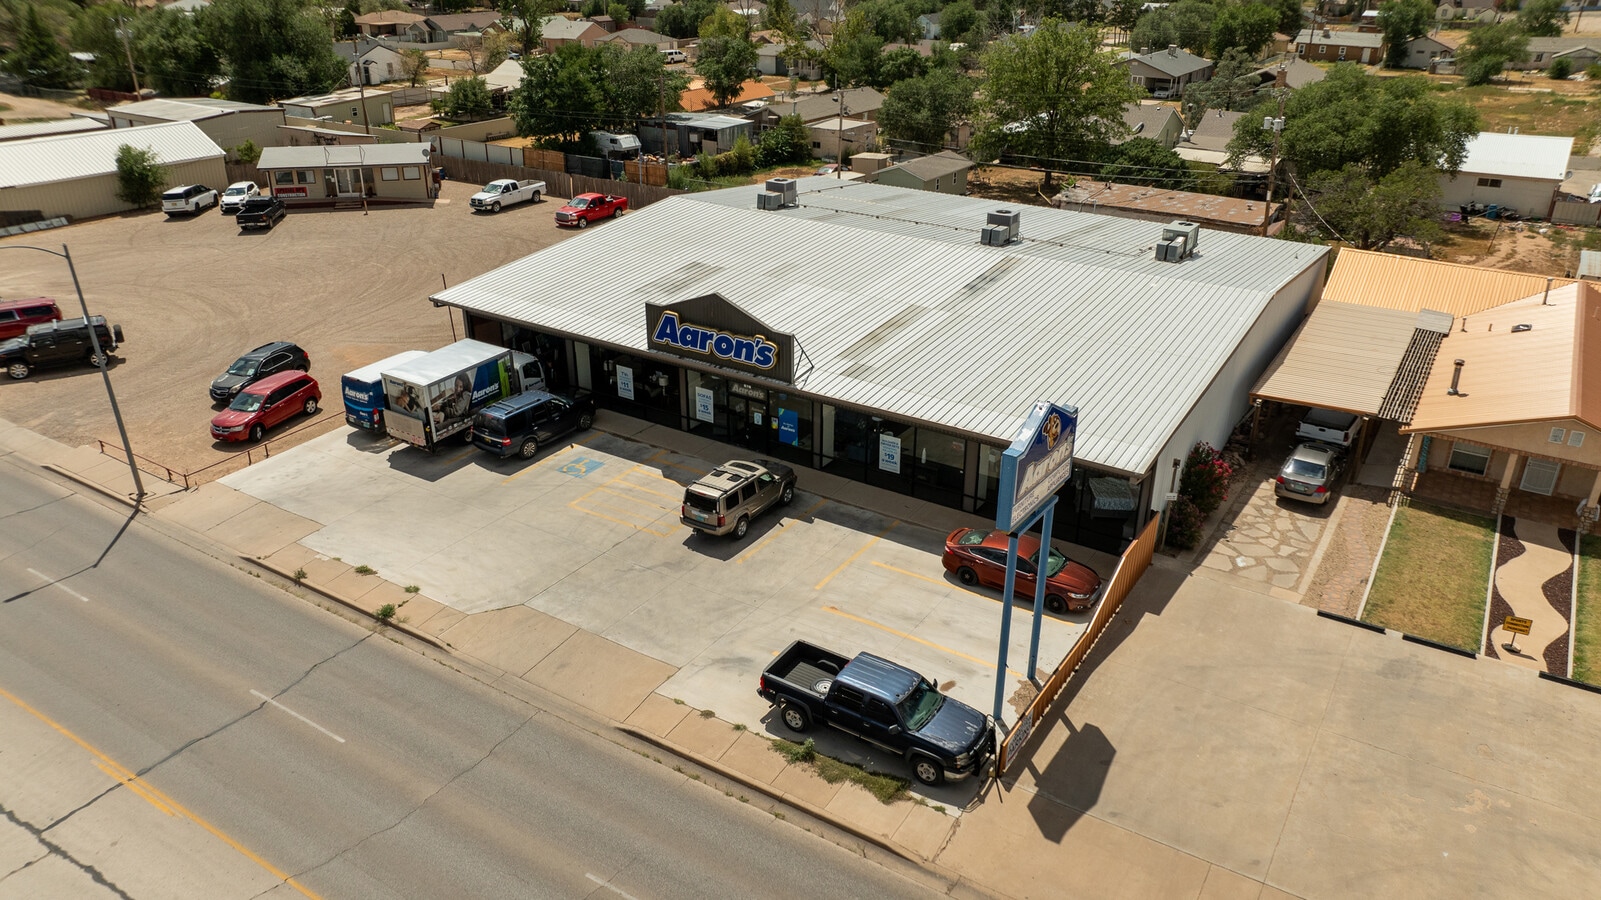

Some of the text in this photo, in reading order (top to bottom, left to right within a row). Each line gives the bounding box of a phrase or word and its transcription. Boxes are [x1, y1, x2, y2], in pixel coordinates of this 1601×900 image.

[653, 312, 777, 369] Aaron's
[345, 386, 369, 400] Aaron's
[472, 382, 499, 401] Aaron's
[732, 384, 764, 398] Aaron's
[884, 453, 895, 461] $19
[1017, 432, 1075, 499] Aaron's
[1011, 495, 1040, 524] ELECTRONICS
